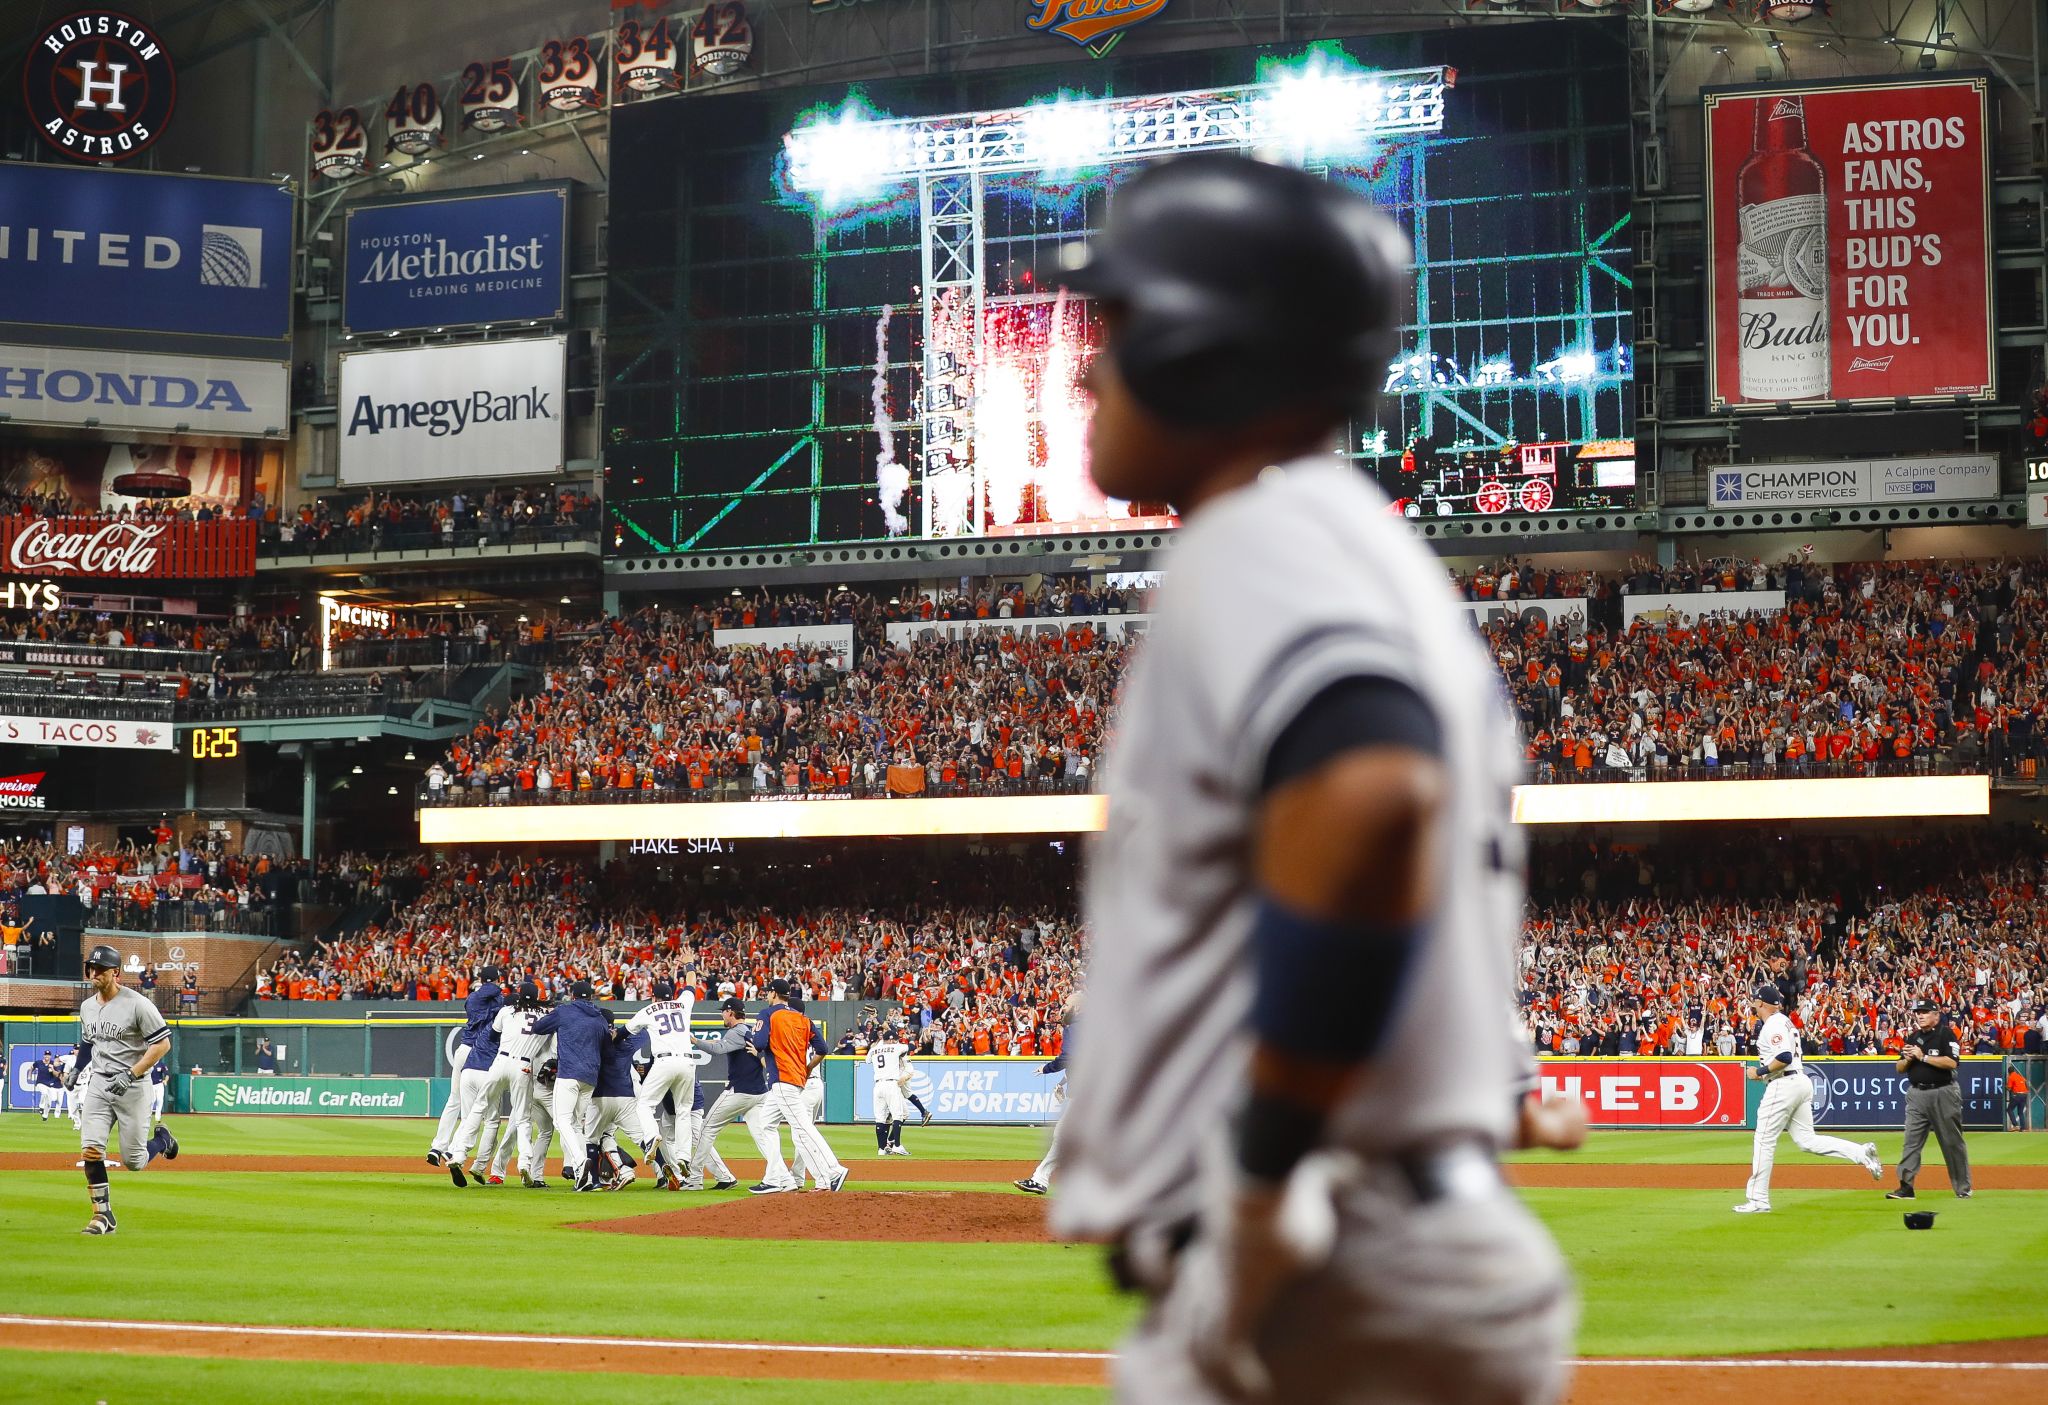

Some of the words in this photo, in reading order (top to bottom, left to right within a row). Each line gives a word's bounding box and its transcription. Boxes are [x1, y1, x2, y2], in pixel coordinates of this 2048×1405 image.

[44, 17, 160, 62] HOUSTON
[615, 16, 672, 65] 34
[692, 1, 747, 47] 42
[540, 36, 592, 84] 33
[76, 60, 127, 111] H
[461, 59, 513, 105] 25
[385, 83, 437, 128] 40
[45, 118, 150, 156] ASTROS
[312, 108, 362, 152] 32
[1842, 116, 1965, 154] ASTROS
[1845, 157, 1932, 193] FANS,
[1844, 196, 1916, 231] THIS
[360, 233, 432, 250] HOUSTON
[1846, 234, 1942, 270] BUD'S
[358, 234, 544, 286] Methodist
[409, 283, 468, 298] LEADING
[475, 278, 543, 294] MEDICINE
[1847, 275, 1908, 308] FOR
[1847, 313, 1920, 348] YOU.
[0, 366, 253, 414] HONDA
[347, 385, 552, 438] AmegyBank
[1745, 470, 1857, 489] CHAMPION
[1884, 467, 1893, 478] A
[1895, 464, 1936, 481] Calpine
[1938, 464, 1991, 480] Company
[1888, 483, 1911, 493] NYSE
[1913, 481, 1934, 492] CPN
[1746, 488, 1794, 501] ENERGY
[1797, 487, 1858, 500] SERVICES
[10, 518, 167, 573] Coca-Cola
[39, 721, 117, 743] TACOS
[193, 728, 238, 759] 0:25
[630, 838, 679, 854] HAKE
[154, 962, 200, 971] LEXUS
[645, 1001, 685, 1017] CENTENO
[654, 1011, 685, 1036] 30
[100, 1021, 127, 1040] YORK
[877, 1054, 886, 1069] 9
[937, 1070, 999, 1091] AT&T
[318, 1091, 347, 1107] Car
[350, 1091, 404, 1108] Rental
[1813, 1101, 1898, 1110] BAPTIST
